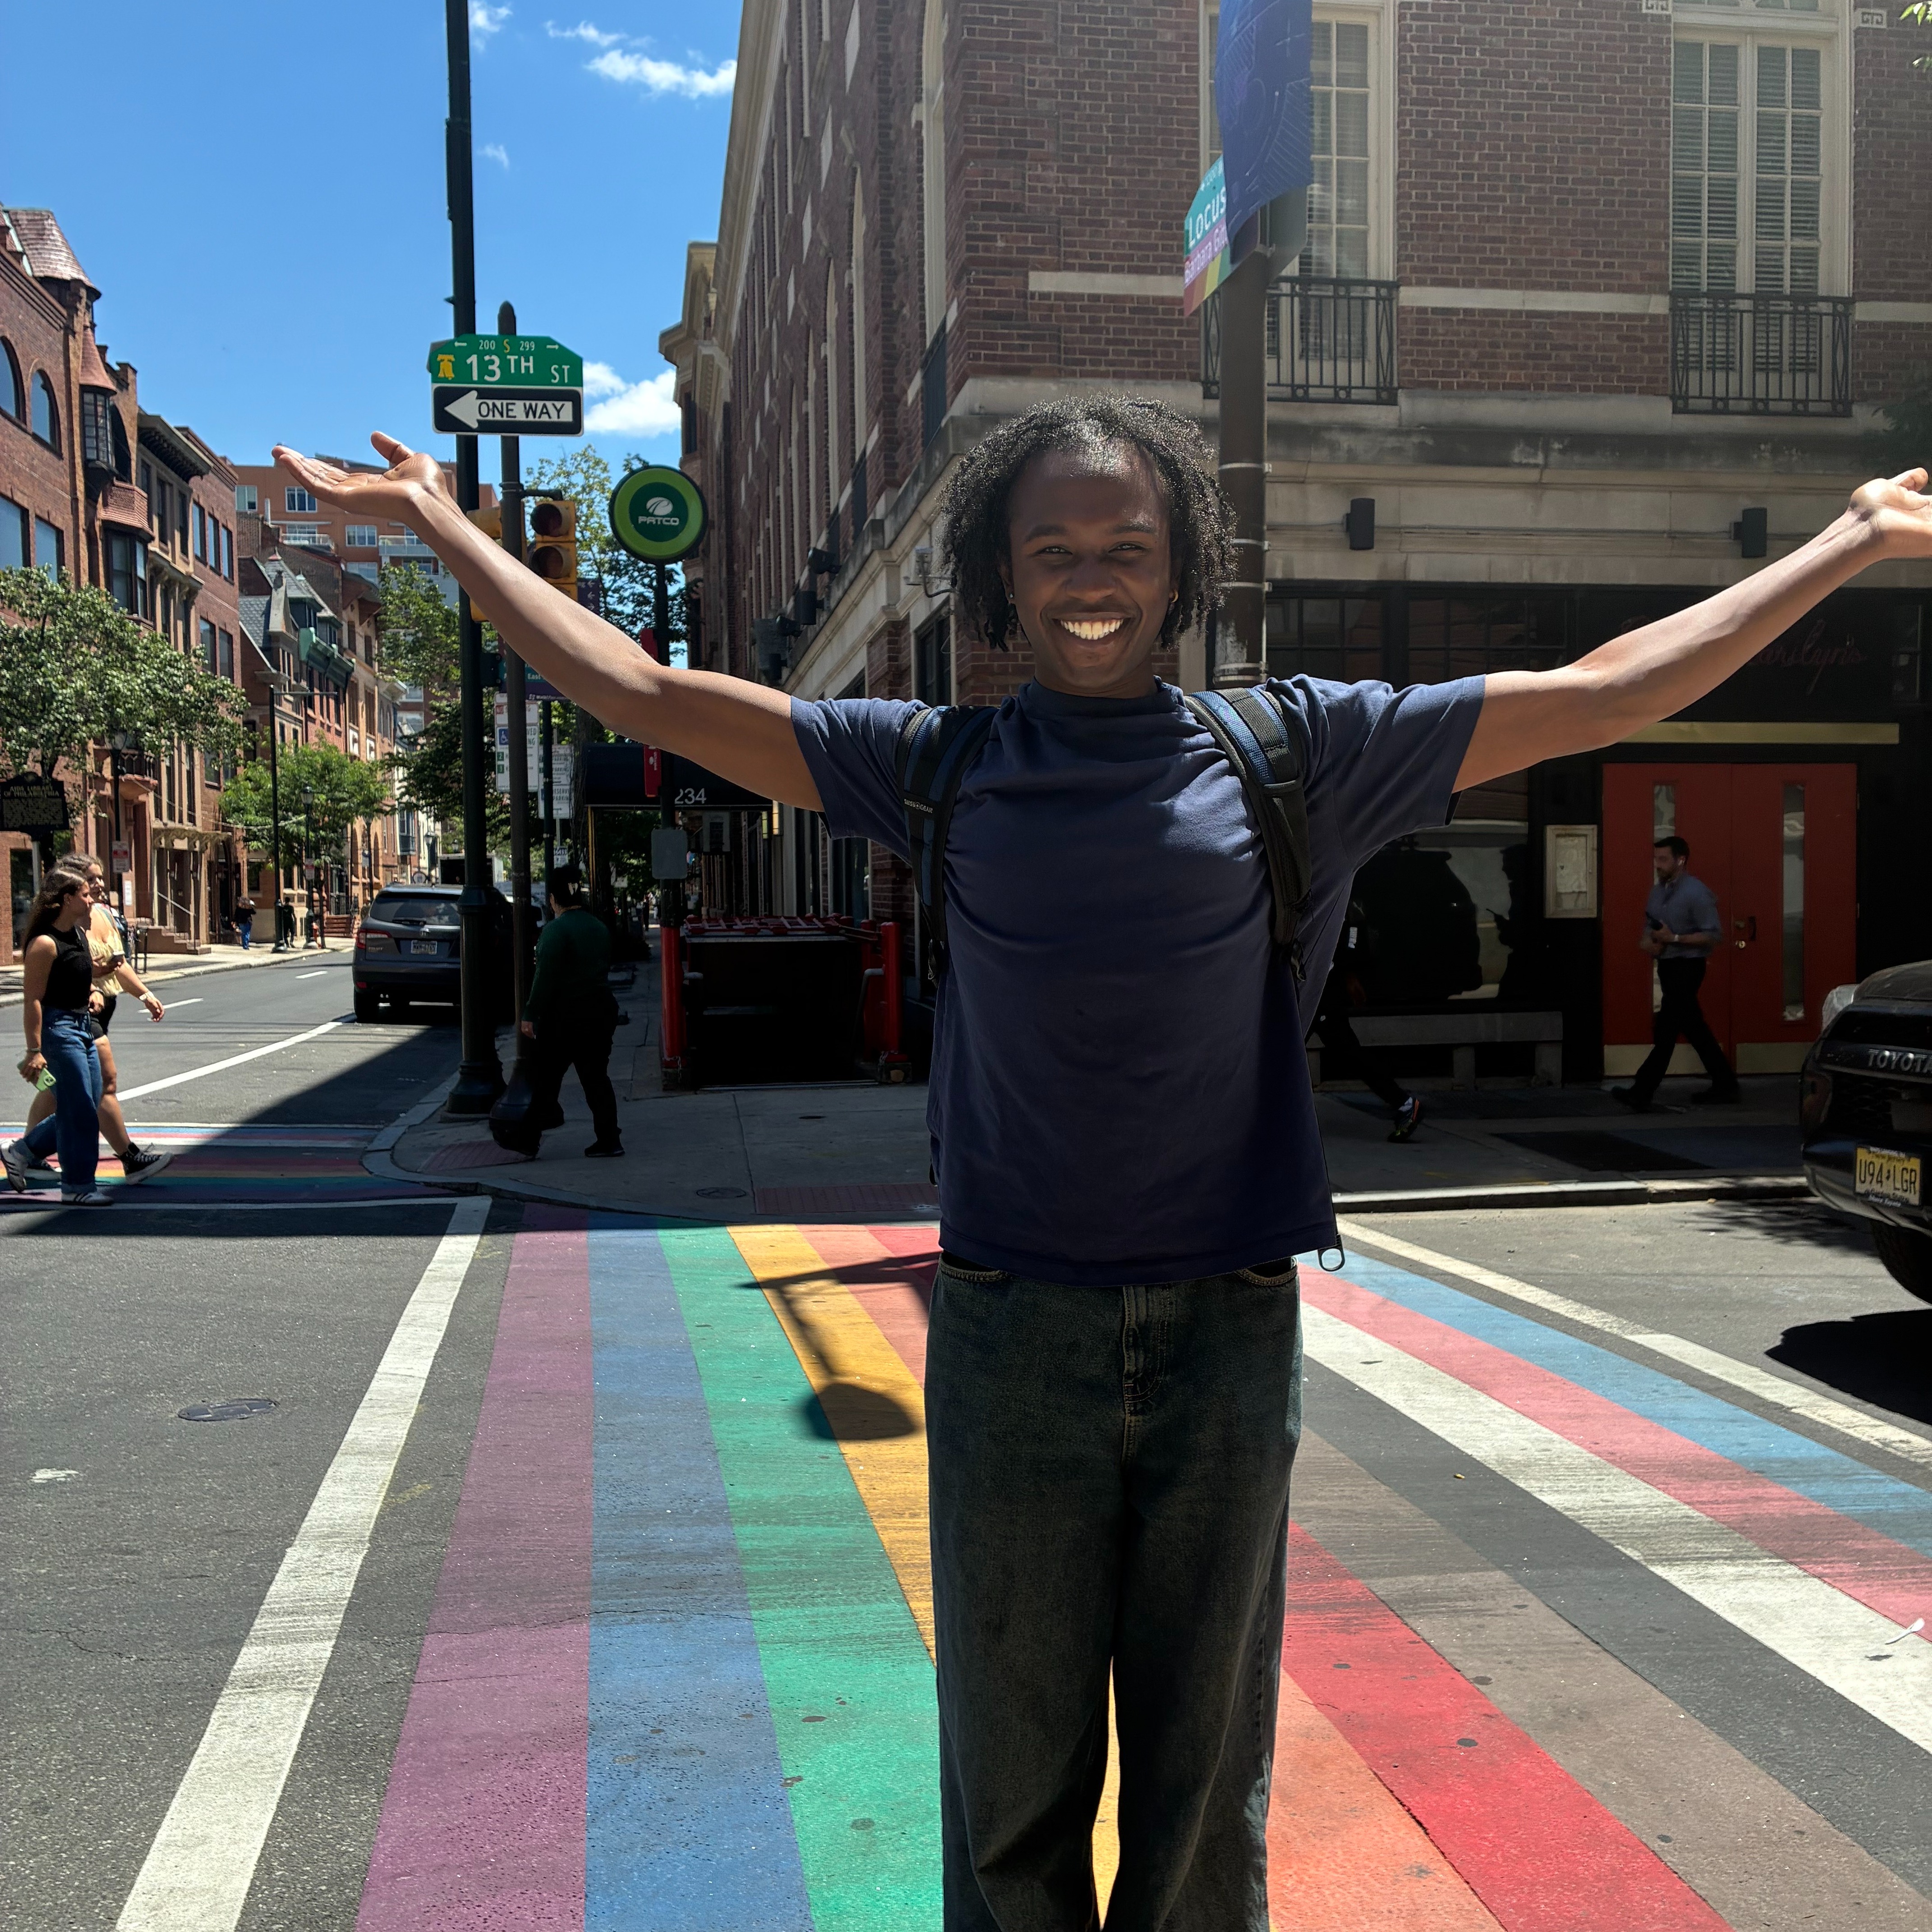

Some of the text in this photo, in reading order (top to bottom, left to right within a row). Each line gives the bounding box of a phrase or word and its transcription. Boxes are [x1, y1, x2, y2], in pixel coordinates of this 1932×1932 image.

[478, 339, 535, 353] 200 S 299
[466, 354, 570, 383] 13TH ST
[478, 401, 565, 419] ONE WAY
[638, 515, 680, 526] PATCO
[674, 788, 707, 805] 234
